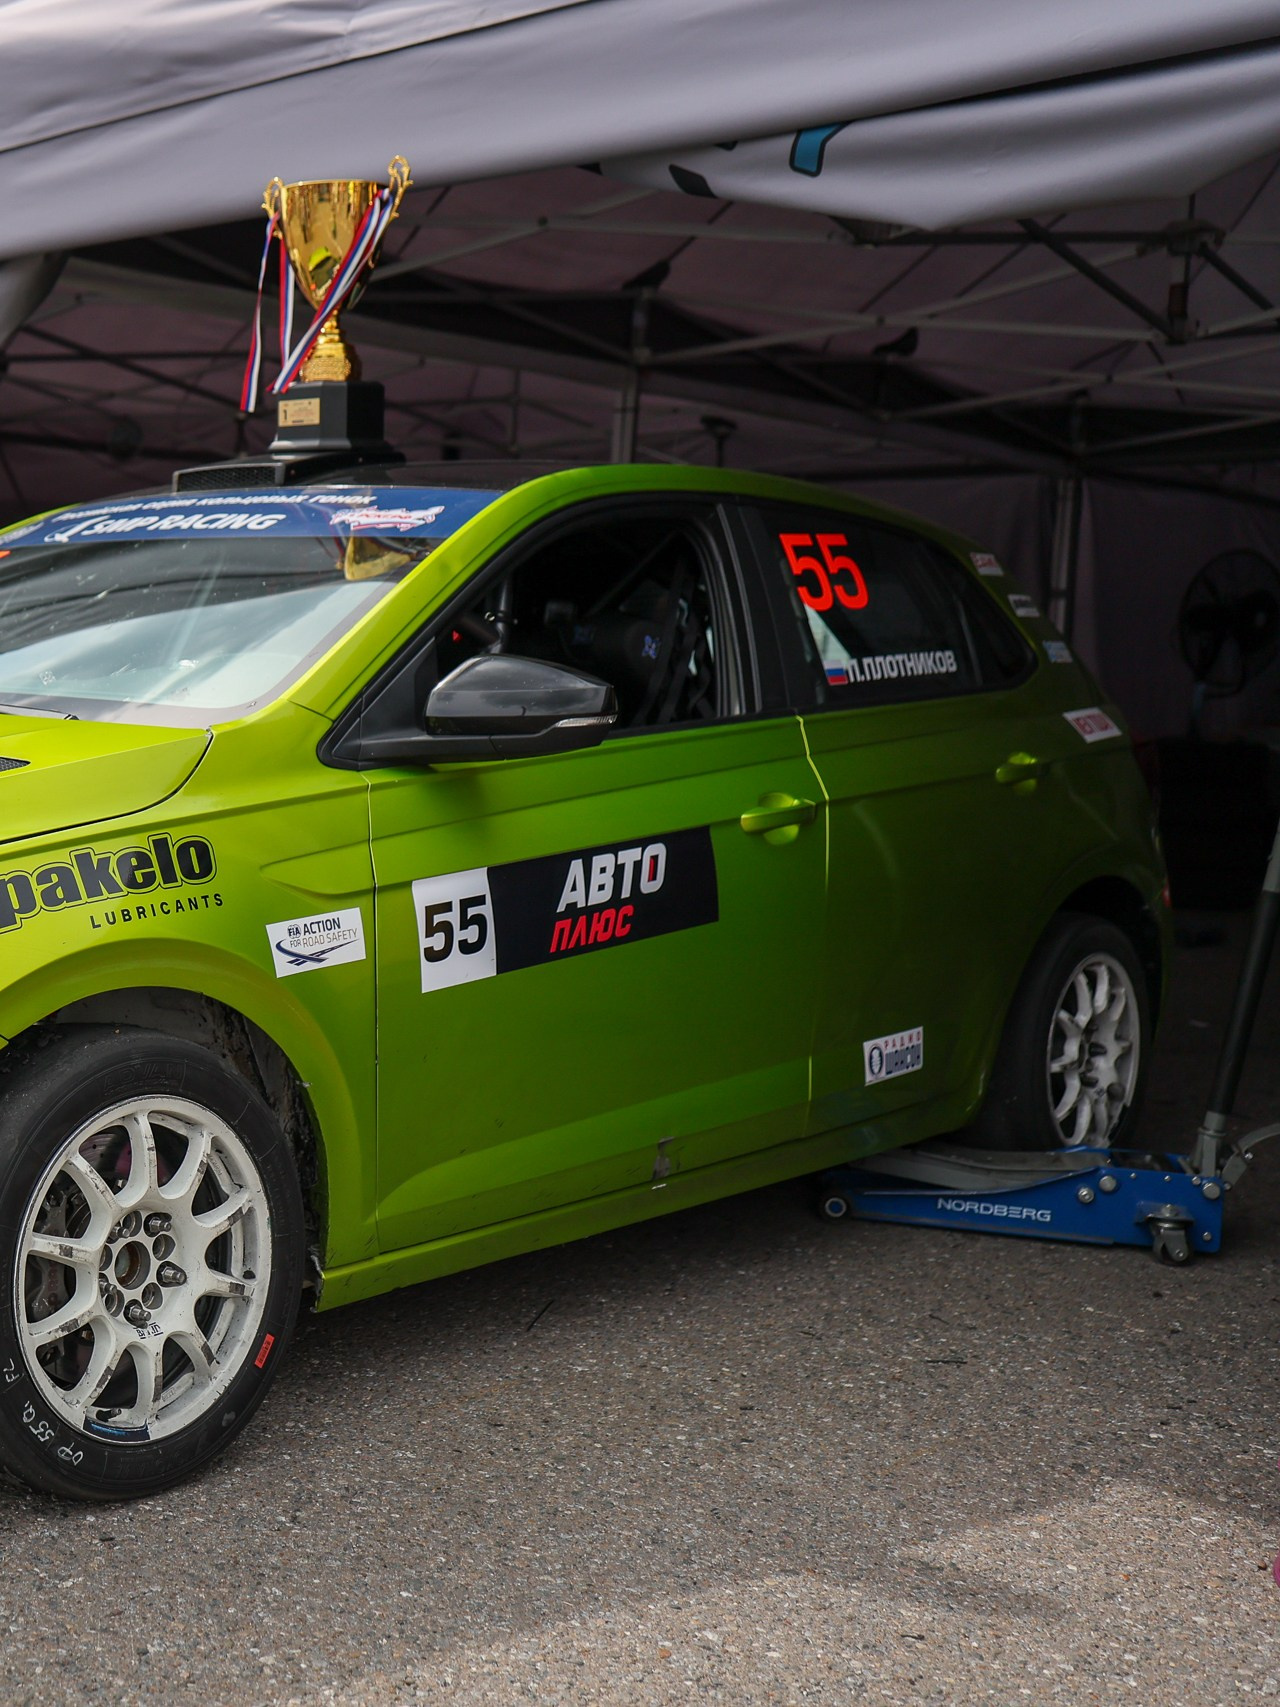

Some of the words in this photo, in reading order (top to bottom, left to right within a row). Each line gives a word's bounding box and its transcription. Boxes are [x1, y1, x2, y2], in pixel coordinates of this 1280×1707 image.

[81, 515, 160, 536] SMP
[147, 513, 287, 531] RACING
[779, 533, 869, 611] 55
[556, 842, 668, 913] АВТО
[90, 893, 224, 929] LUBRICANTS
[303, 917, 341, 936] ACTION
[423, 894, 488, 963] 55
[549, 904, 616, 953] ПЛЮС
[290, 939, 302, 948] FOR
[302, 934, 325, 948] ROAD
[326, 928, 358, 943] SAFETY
[937, 1198, 1052, 1222] NORDBERG
